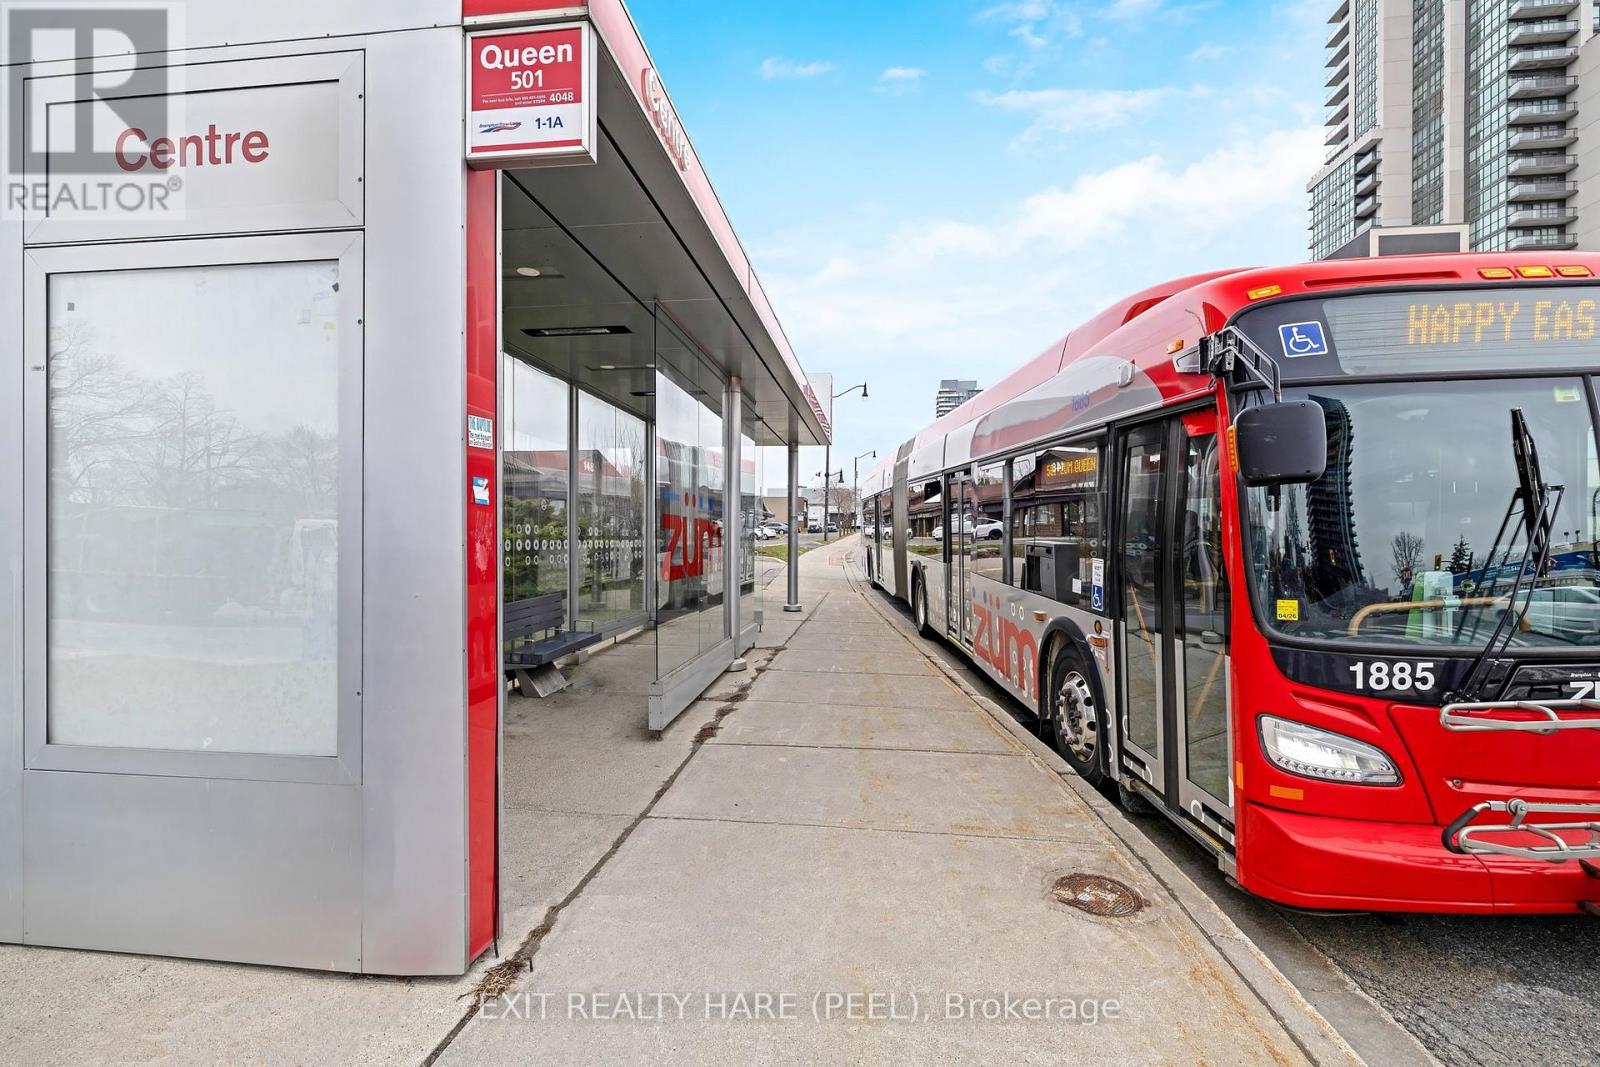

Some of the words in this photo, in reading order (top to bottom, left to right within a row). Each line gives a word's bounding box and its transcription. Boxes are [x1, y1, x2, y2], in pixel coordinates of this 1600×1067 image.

[480, 44, 573, 69] Queen
[511, 70, 543, 89] 501
[549, 92, 574, 102] 4048
[535, 116, 564, 129] 1-1A
[115, 124, 270, 171] Centre
[1408, 301, 1521, 345] HAPPY
[1534, 299, 1596, 342] EAS
[972, 592, 1039, 702] züm
[1349, 661, 1435, 690] 1885
